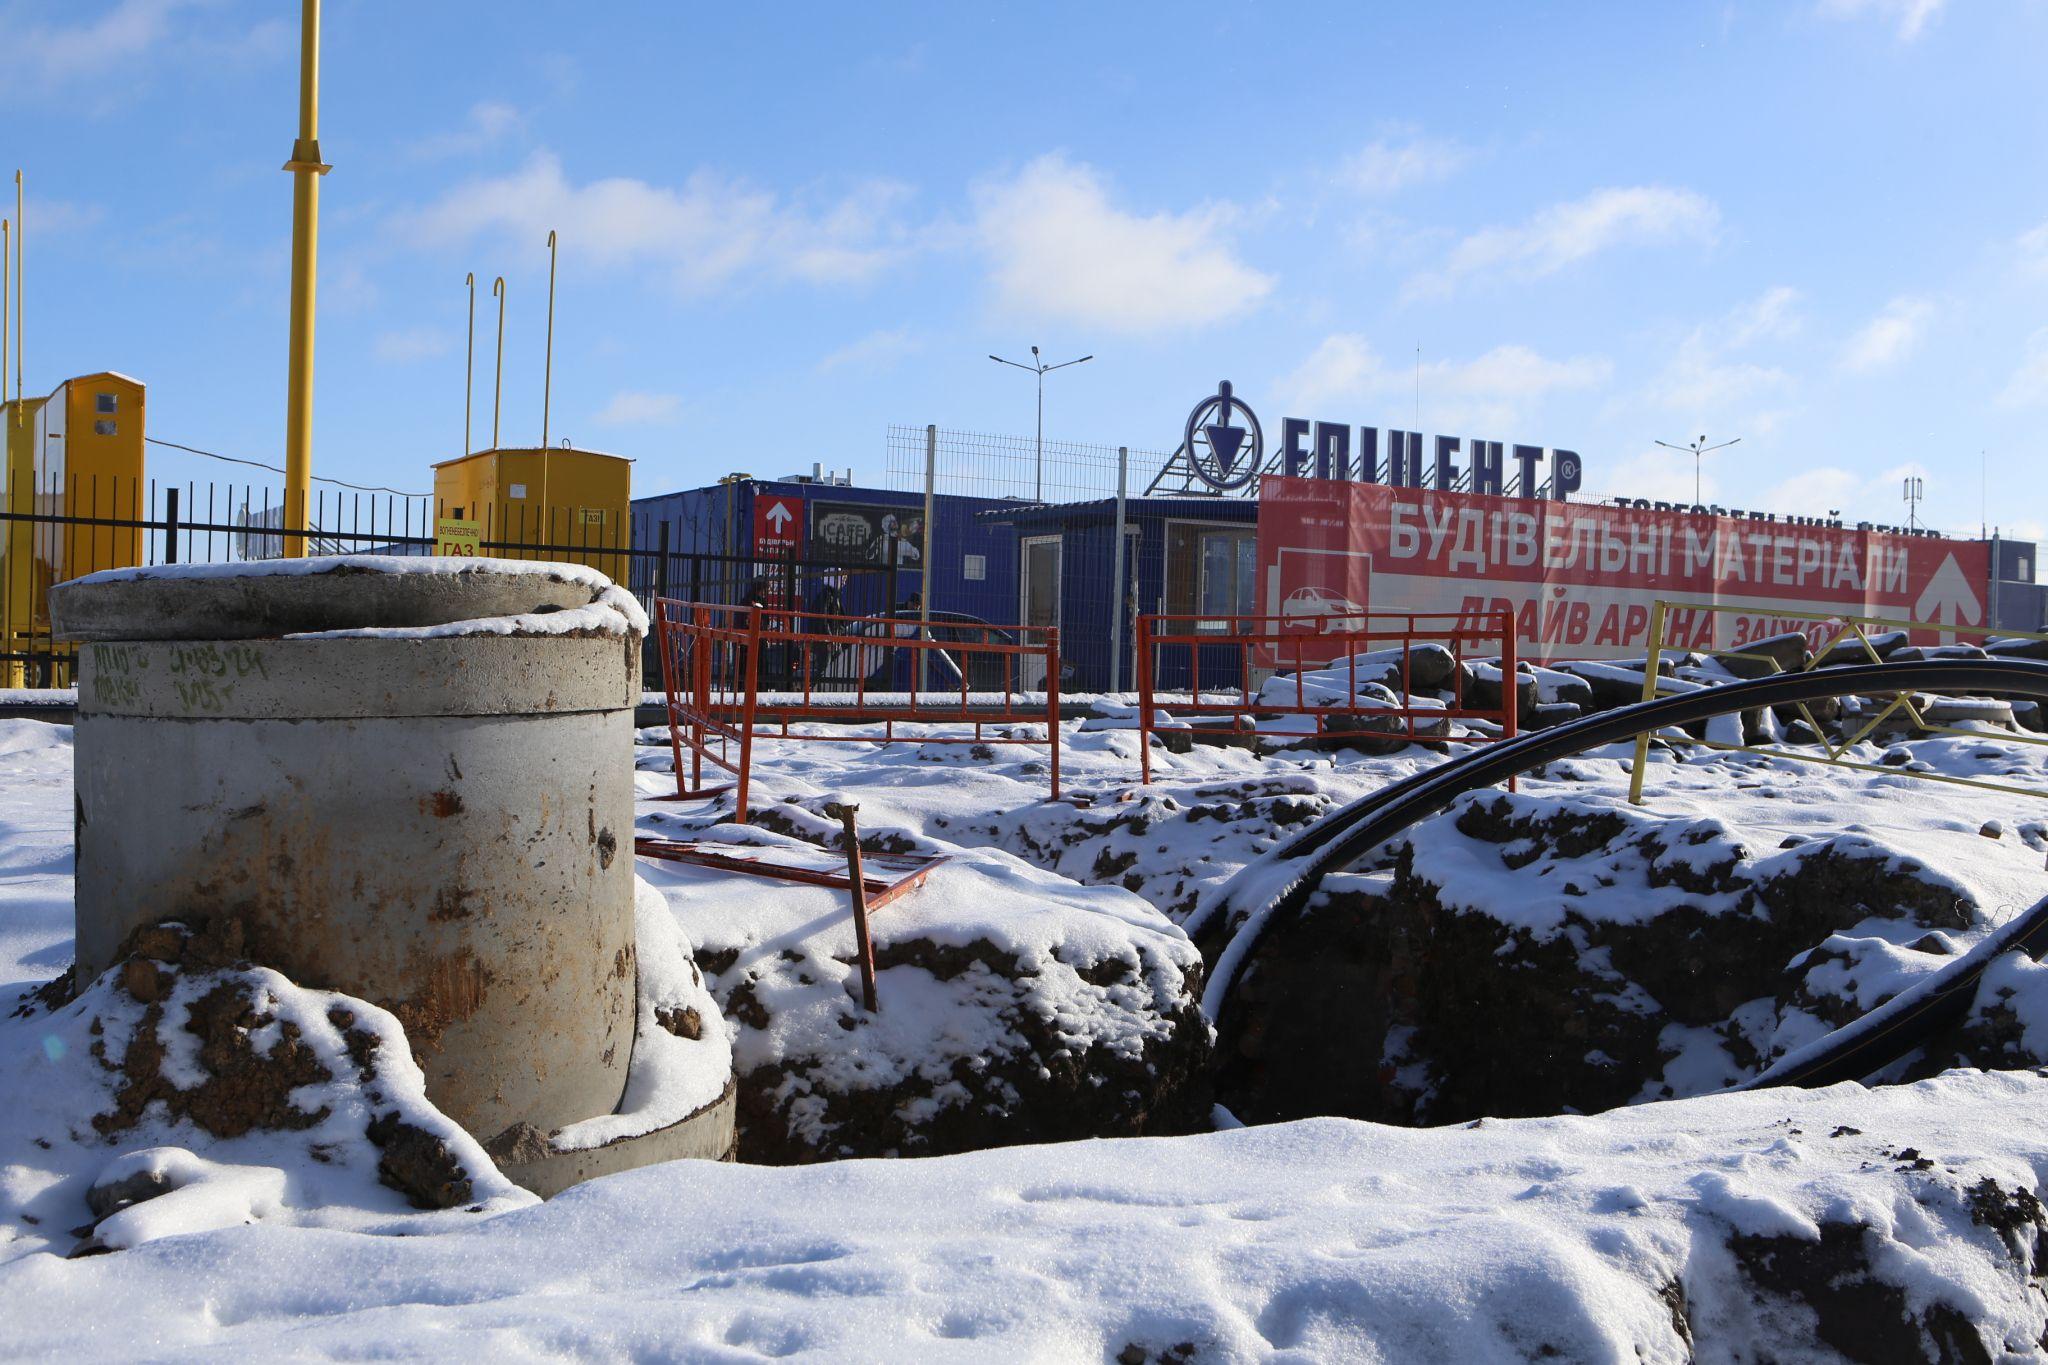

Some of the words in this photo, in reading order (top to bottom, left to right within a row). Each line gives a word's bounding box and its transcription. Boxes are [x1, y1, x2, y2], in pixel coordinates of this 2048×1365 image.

[444, 542, 474, 557] ГАЗ
[1390, 502, 1670, 577] БУДІВЕЛЬНІ
[1685, 526, 1909, 594] МАТЕРІАЛИ
[1453, 586, 1591, 649] ДРАЙВ
[1595, 603, 1716, 650] АРНА
